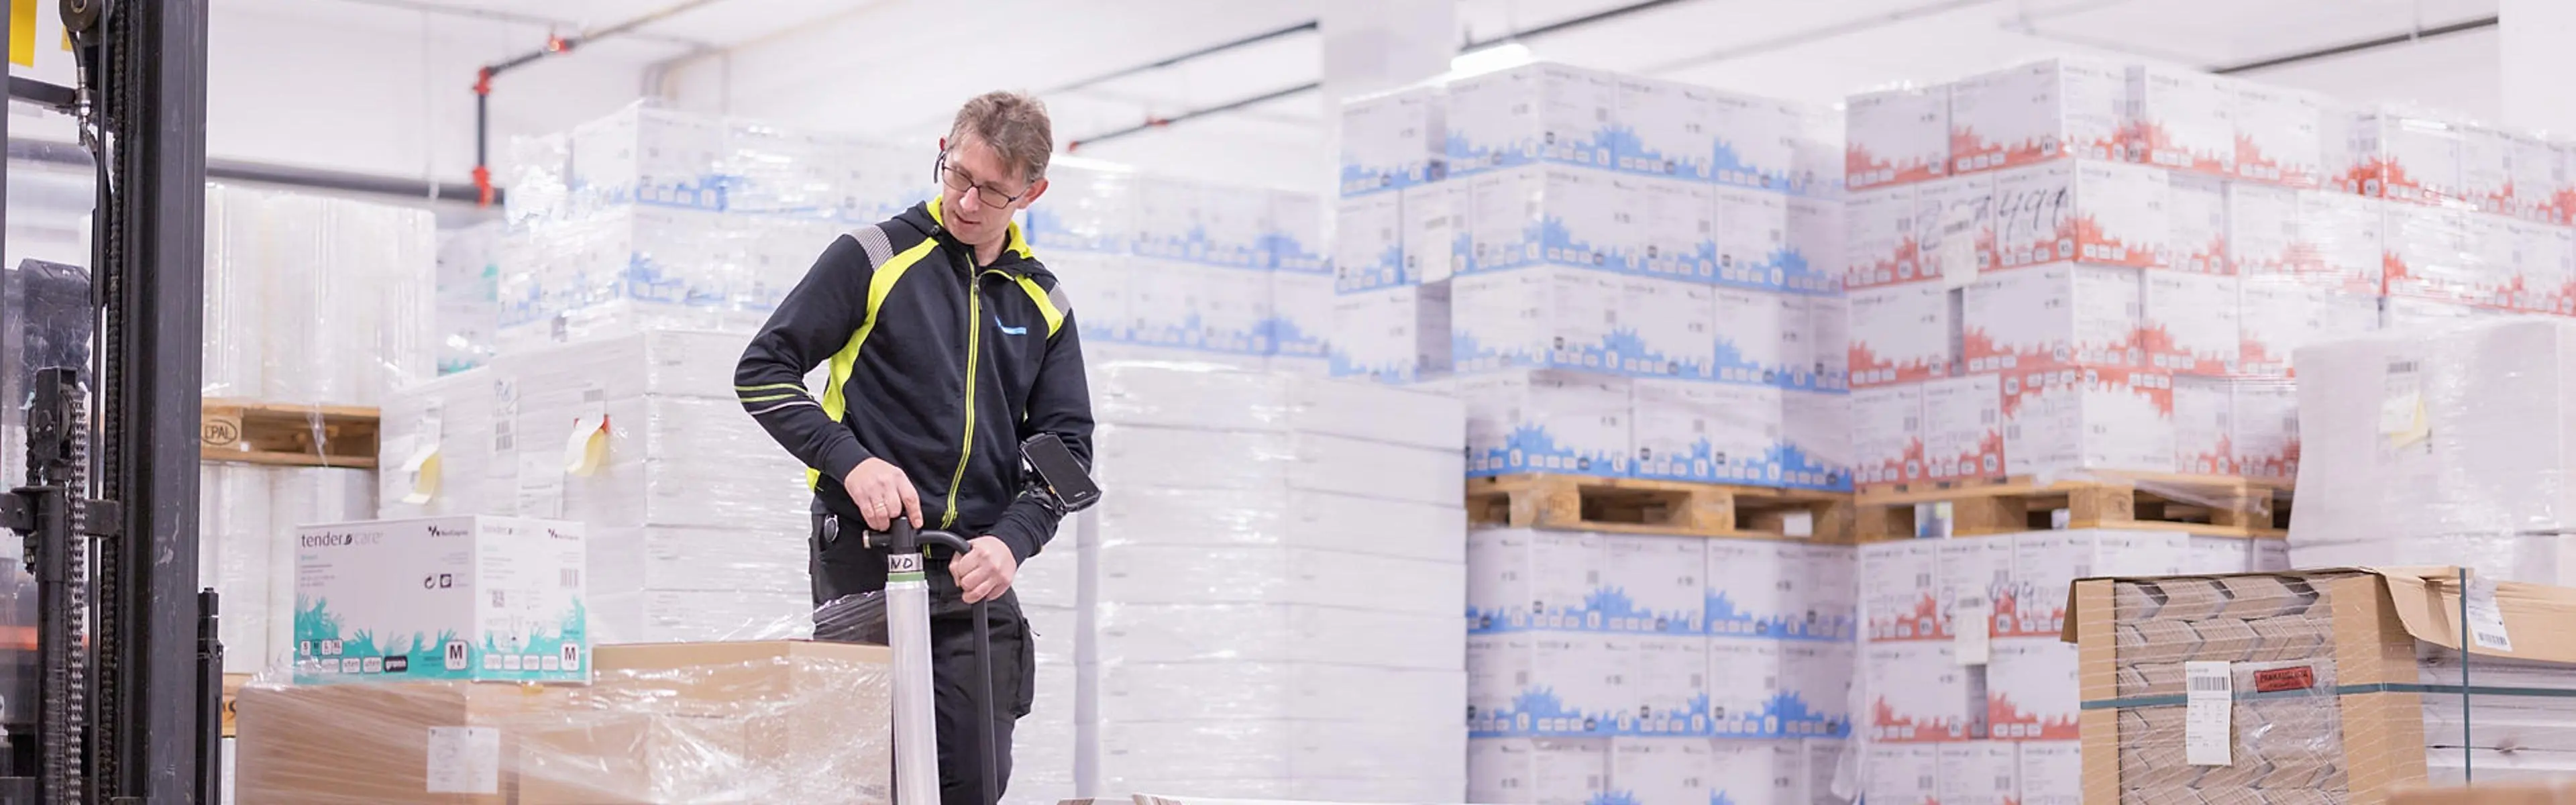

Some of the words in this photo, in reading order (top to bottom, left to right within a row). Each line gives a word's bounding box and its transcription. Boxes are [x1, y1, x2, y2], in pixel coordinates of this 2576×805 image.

[301, 531, 343, 548] tender
[450, 645, 462, 659] M
[565, 647, 576, 661] M
